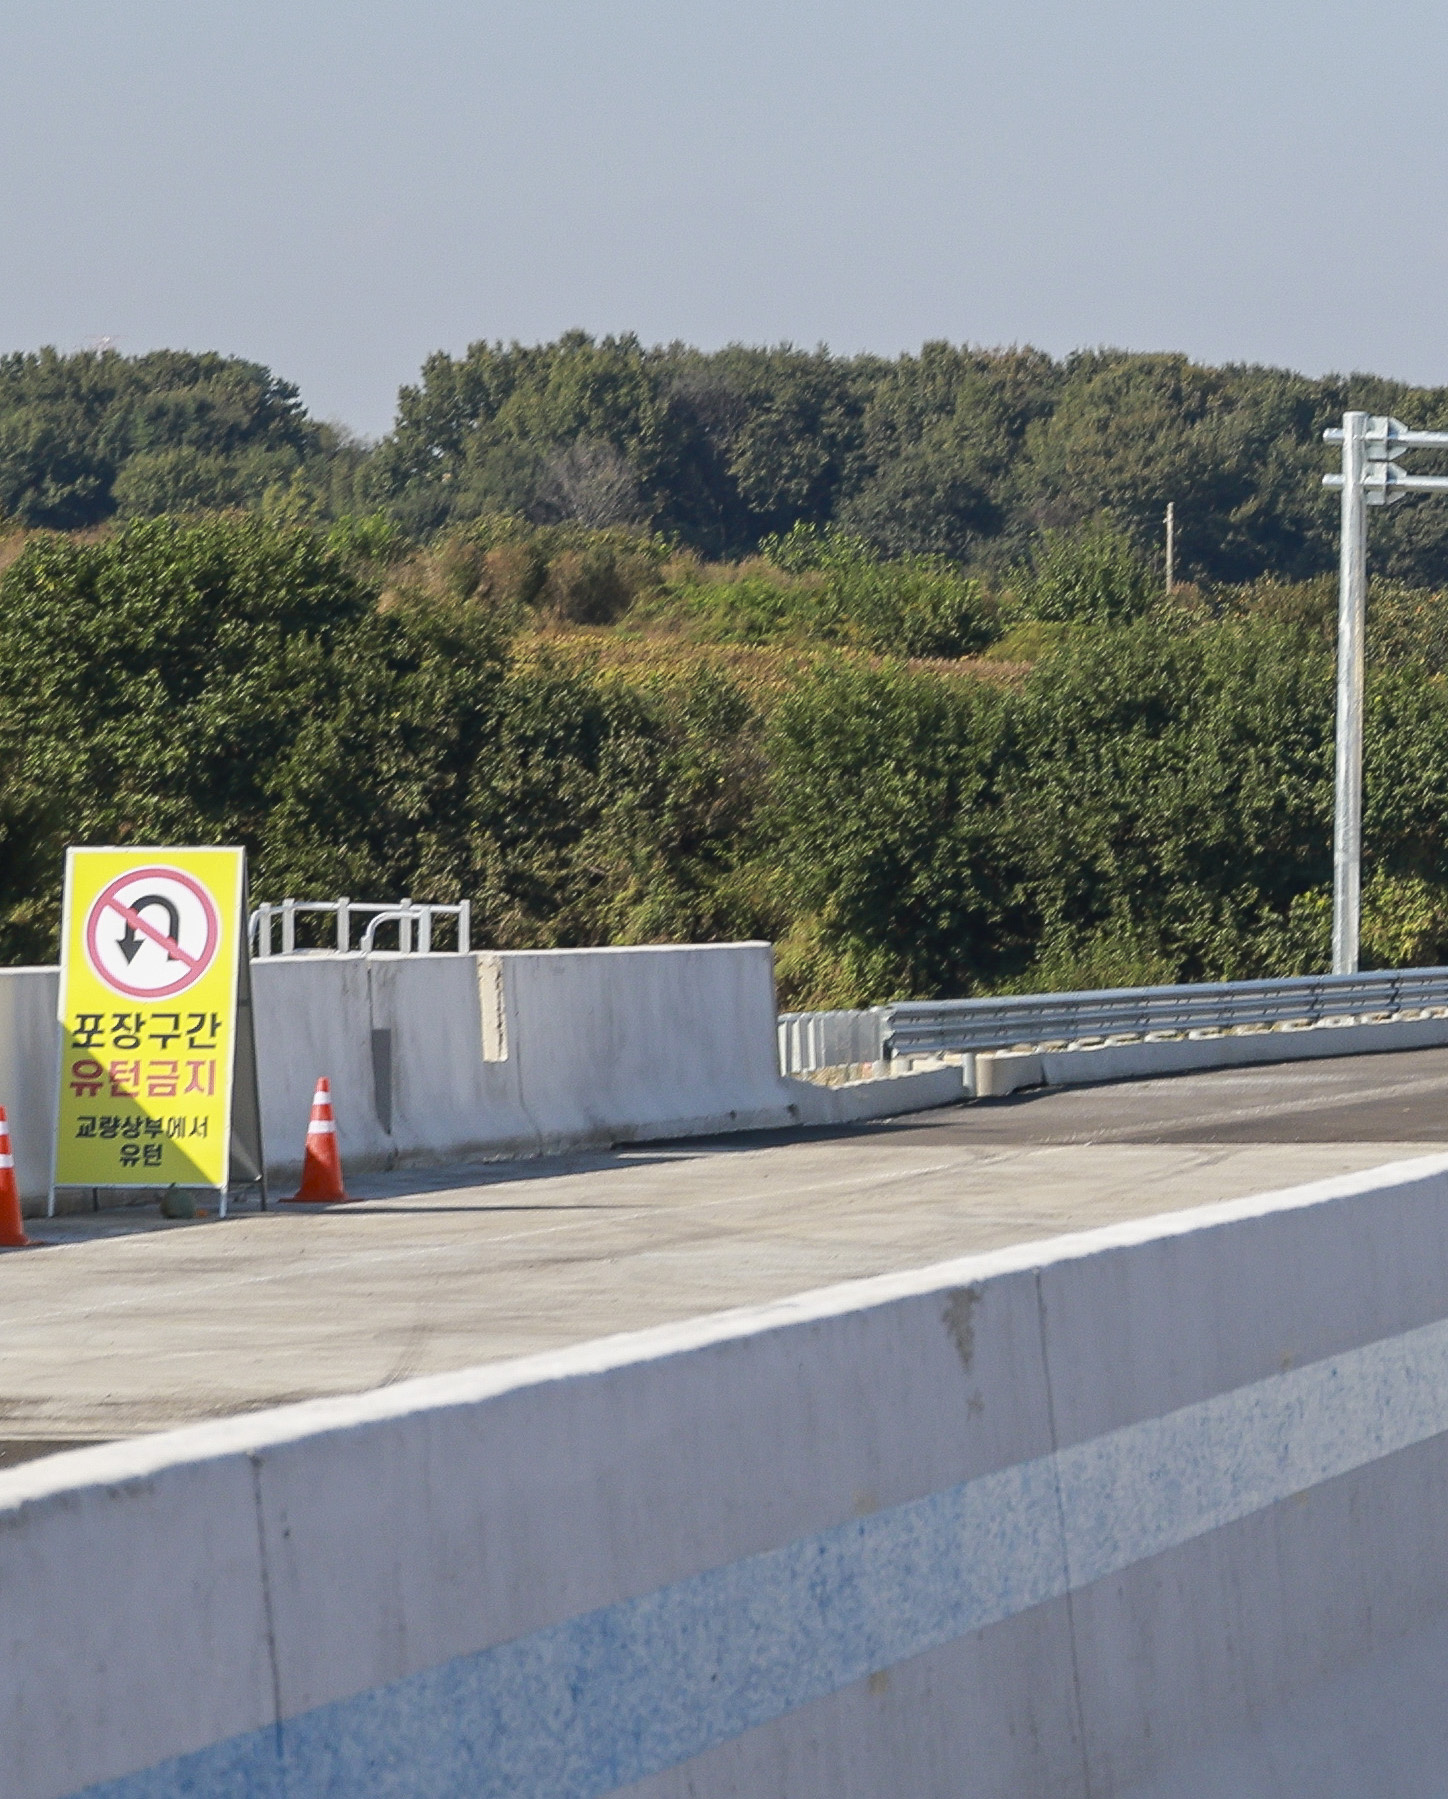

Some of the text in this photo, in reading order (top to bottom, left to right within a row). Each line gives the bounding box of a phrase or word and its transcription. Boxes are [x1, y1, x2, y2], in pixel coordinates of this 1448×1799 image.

[72, 1012, 222, 1049] 포장구간
[70, 1059, 216, 1097] 유턴금지
[75, 1115, 208, 1139] 교량상부에서
[119, 1143, 162, 1166] 유턴
